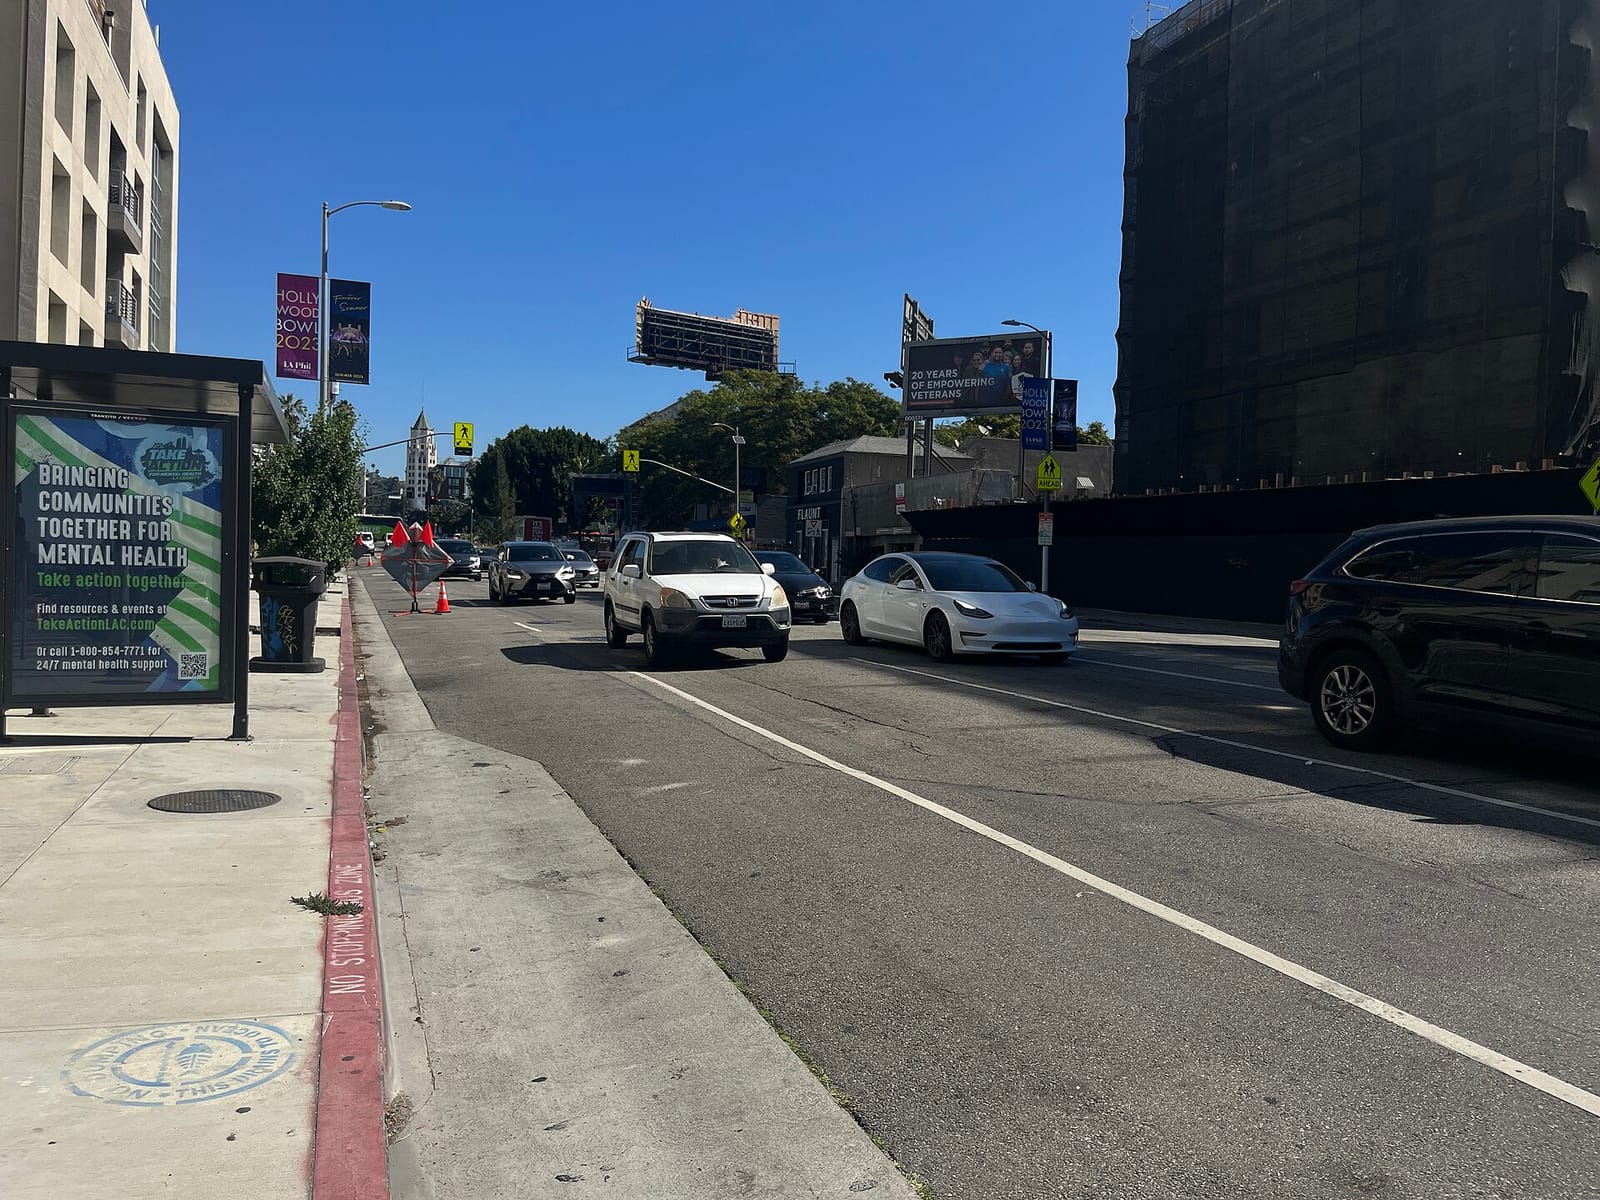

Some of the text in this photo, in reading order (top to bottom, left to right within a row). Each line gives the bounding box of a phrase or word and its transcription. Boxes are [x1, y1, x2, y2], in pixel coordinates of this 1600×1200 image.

[277, 290, 319, 304] HOLLY
[277, 305, 319, 318] WOOD
[276, 319, 319, 334] BOWL
[276, 334, 319, 351] 2023
[295, 361, 311, 370] Phil
[911, 369, 958, 380] 20 YEARS
[911, 378, 995, 390] OF EMPOWERING
[911, 389, 962, 400] VETERANS
[150, 449, 188, 460] TAKE
[147, 459, 203, 471] ACTION
[39, 464, 130, 489] BRINGING
[1039, 479, 1061, 488] AHEAD
[38, 491, 174, 516] COMMUNITIES
[797, 507, 821, 521] FLAUNT
[37, 517, 172, 541] TOGETHER FOR
[38, 544, 188, 567] MENTAL HEALTH
[37, 572, 186, 591] Take action together
[37, 603, 167, 614] Find resources & events at
[37, 618, 156, 631] TakeActionLAC.com
[36, 646, 161, 657] Or call 1-800-854-7771 for
[36, 659, 168, 671] 24/7 mental health support
[334, 863, 362, 884] ZONE
[329, 975, 366, 994] NO
[194, 1024, 262, 1038] OCEAN
[232, 1048, 280, 1083] DRAINS
[176, 1081, 230, 1098] THIS
